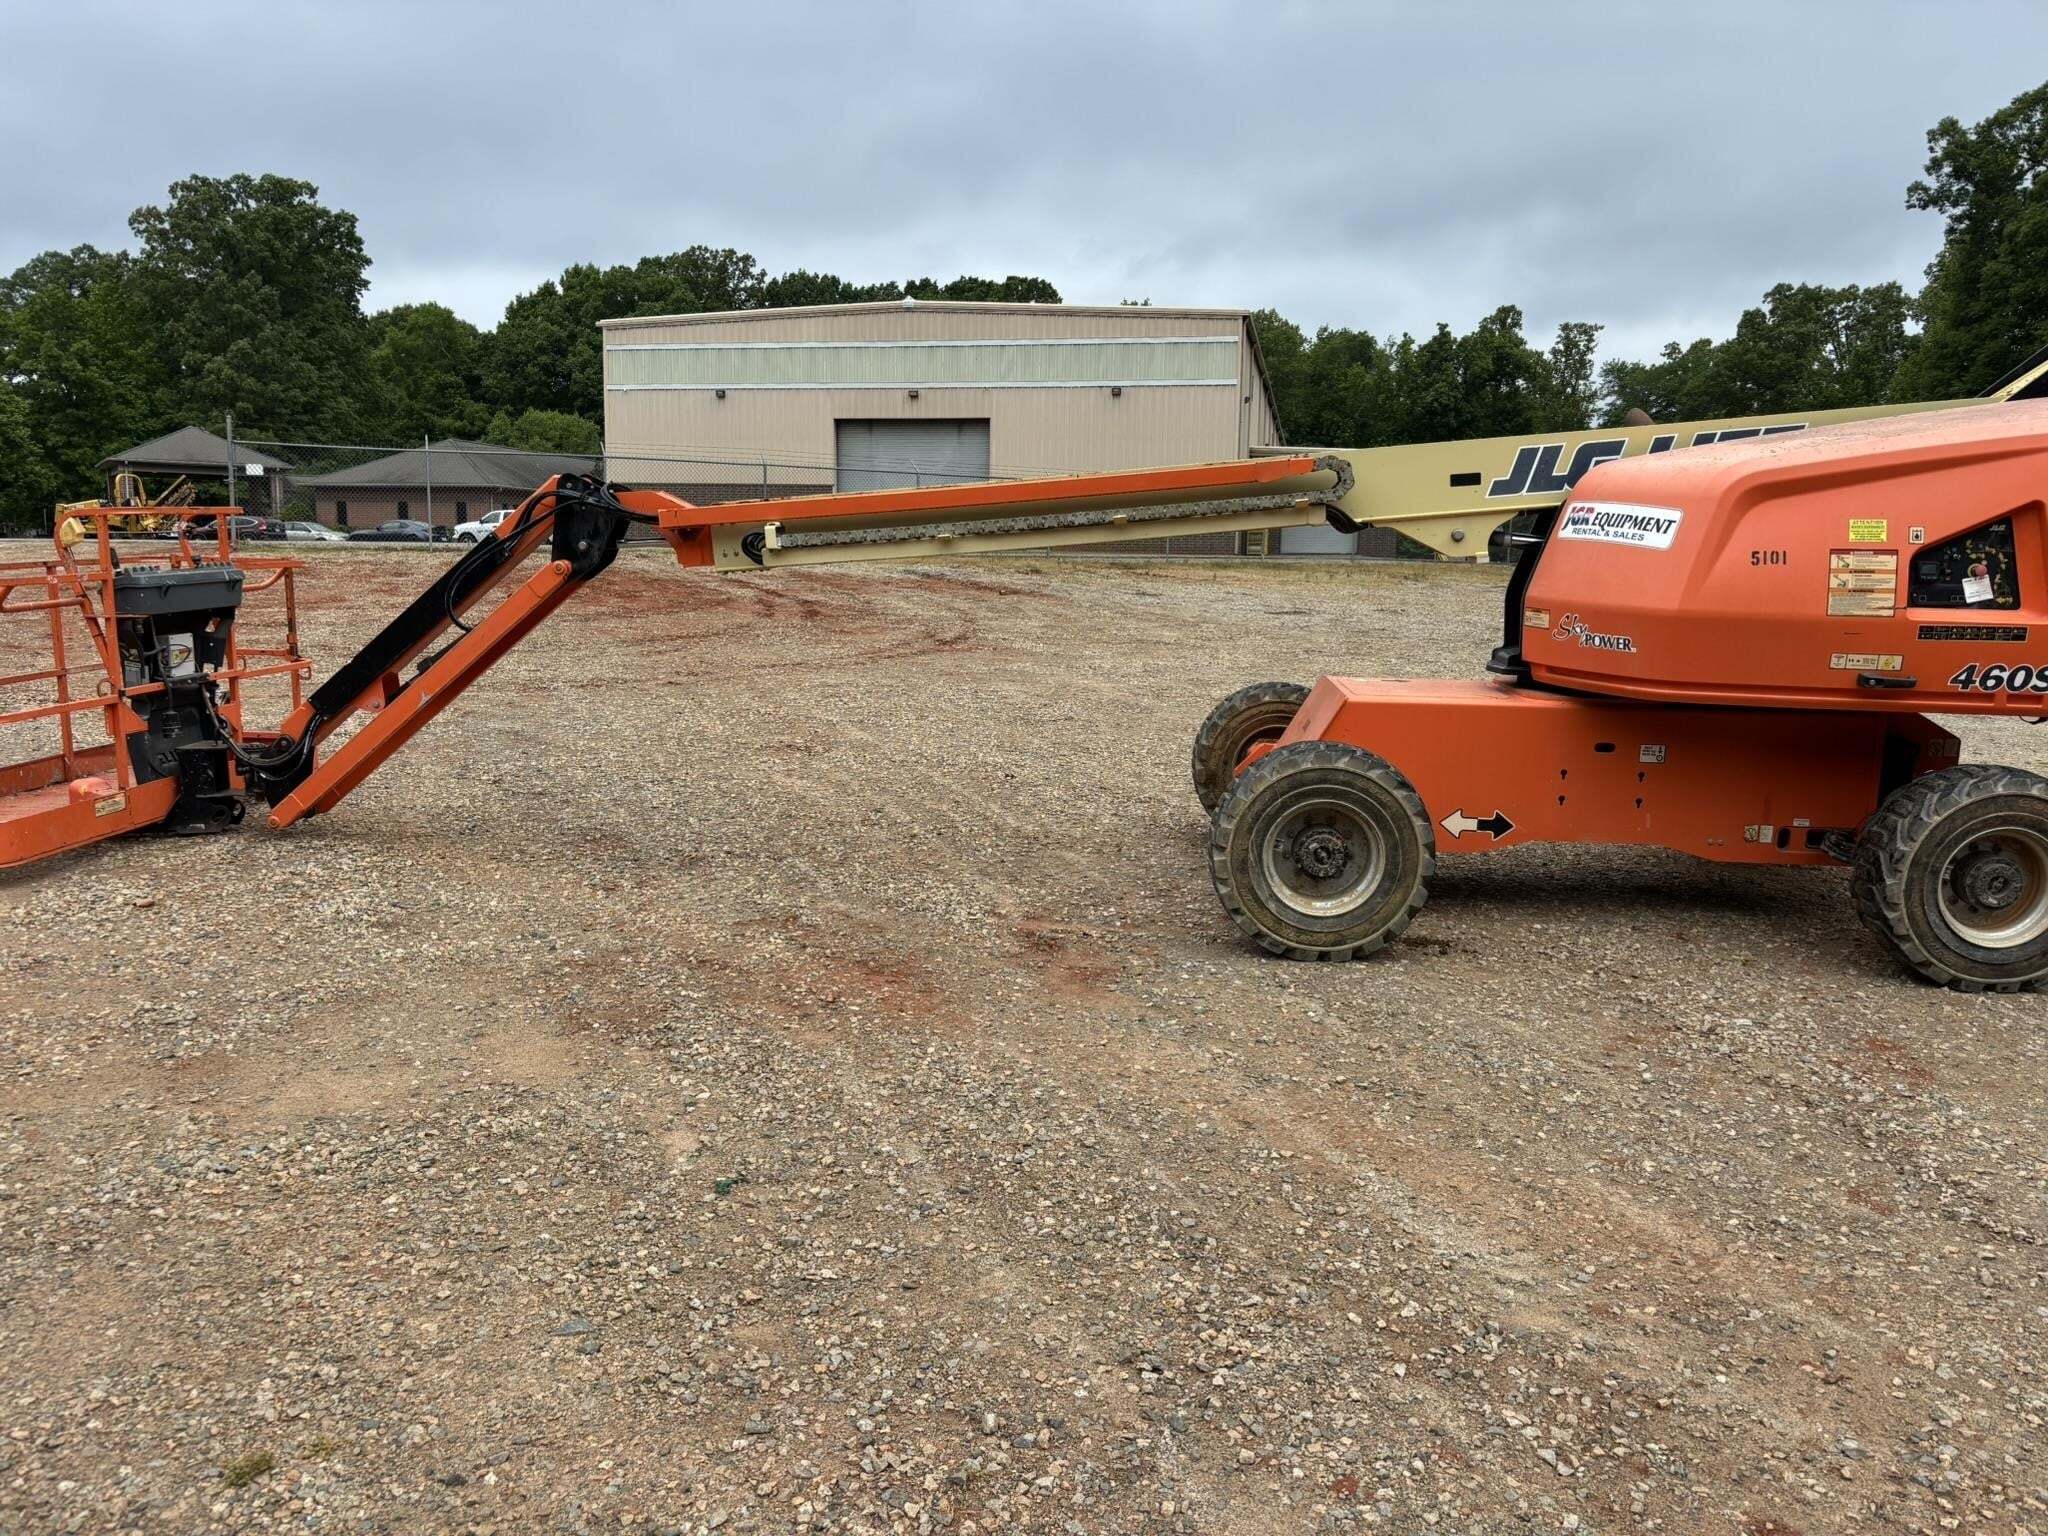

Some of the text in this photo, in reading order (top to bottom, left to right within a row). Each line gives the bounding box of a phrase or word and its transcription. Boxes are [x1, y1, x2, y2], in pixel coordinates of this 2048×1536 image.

[1591, 511, 1677, 534] EQUIPMENT
[1571, 527, 1645, 541] RENTAL & SALES
[1751, 550, 1787, 566] 5101
[1551, 612, 1589, 648] Sky
[1583, 632, 1632, 652] POWER
[1948, 662, 2048, 693] 460S
